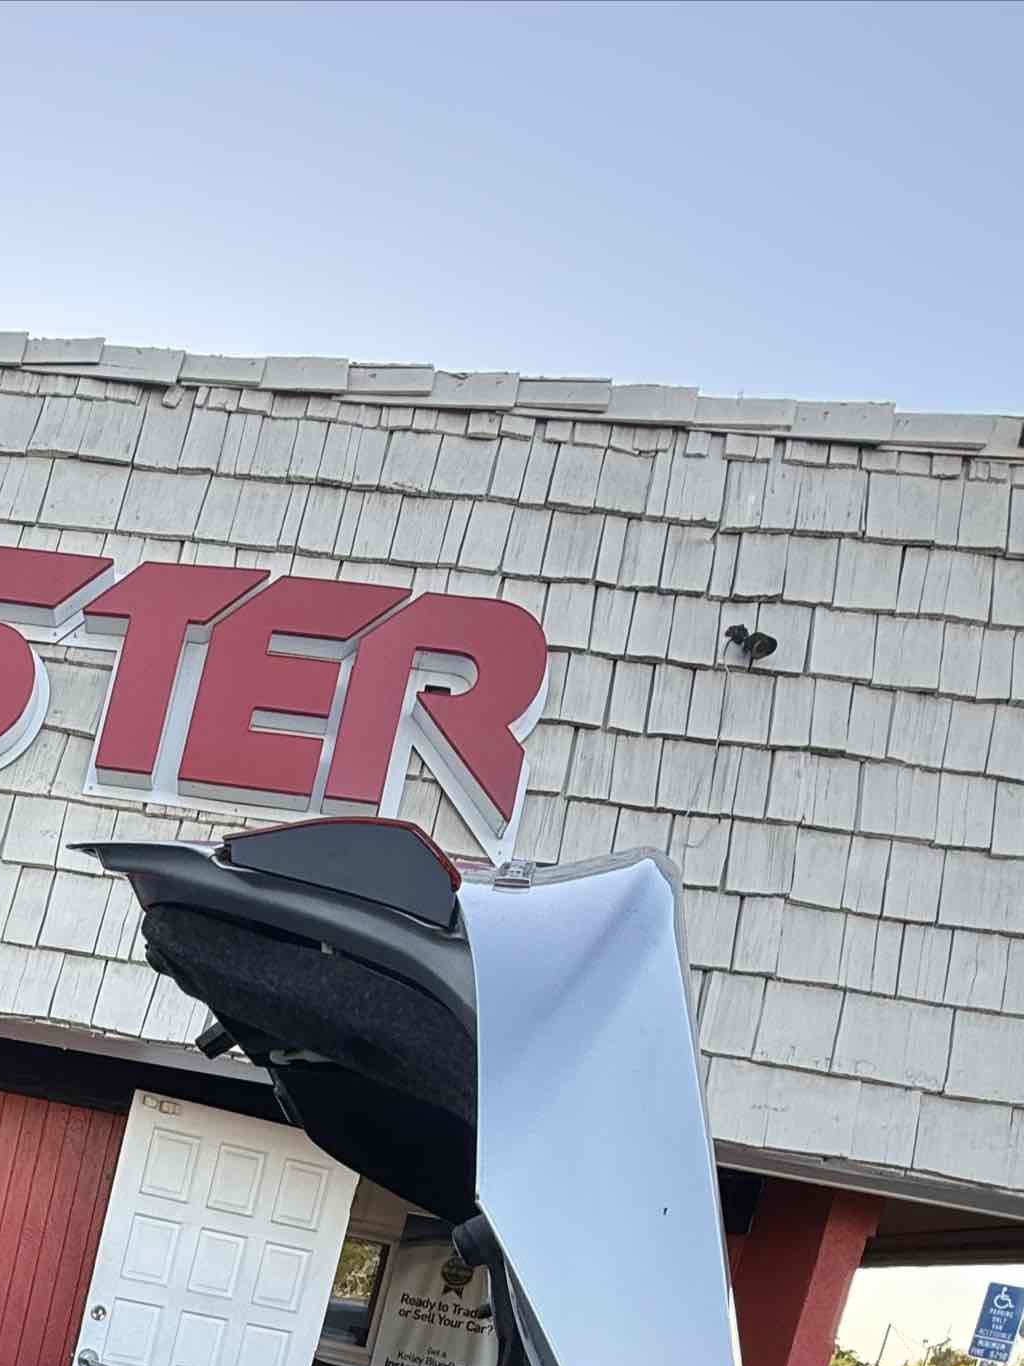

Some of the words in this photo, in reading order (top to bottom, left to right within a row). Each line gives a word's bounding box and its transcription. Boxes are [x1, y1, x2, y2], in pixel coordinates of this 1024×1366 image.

[400, 1293, 437, 1310] Ready
[438, 1301, 449, 1312] to
[452, 1304, 483, 1319] Trad
[398, 1308, 412, 1317] or
[413, 1308, 436, 1324] Sell
[438, 1313, 464, 1329] Your
[465, 1320, 494, 1334] Car?
